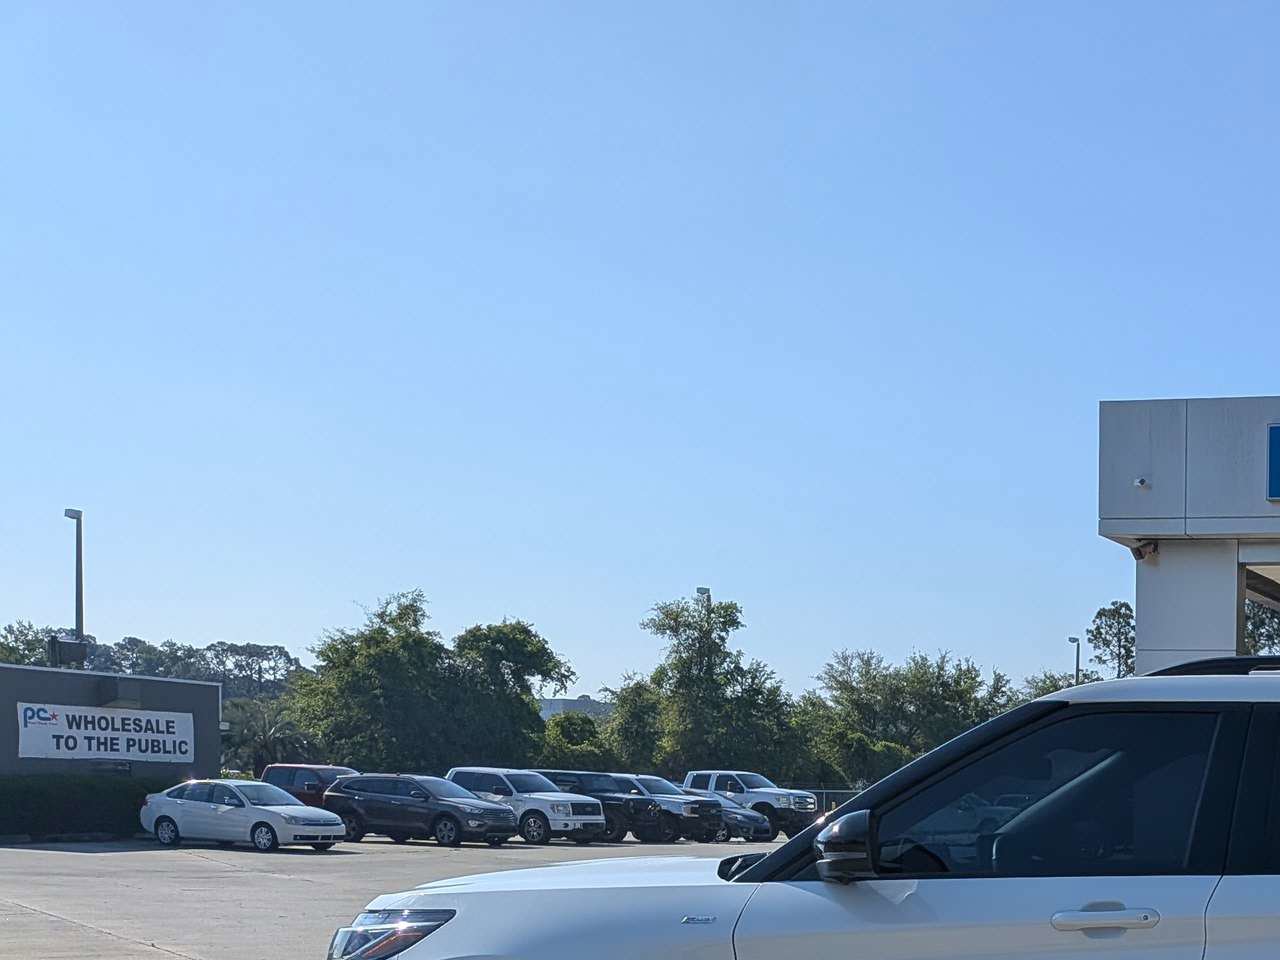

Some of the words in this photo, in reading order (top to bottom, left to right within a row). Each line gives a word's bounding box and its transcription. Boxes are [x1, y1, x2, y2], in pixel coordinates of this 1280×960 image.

[65, 713, 176, 735] WHOLESALE
[51, 734, 78, 751] TO
[84, 735, 120, 753] THE
[126, 737, 189, 755] PUBLIC
